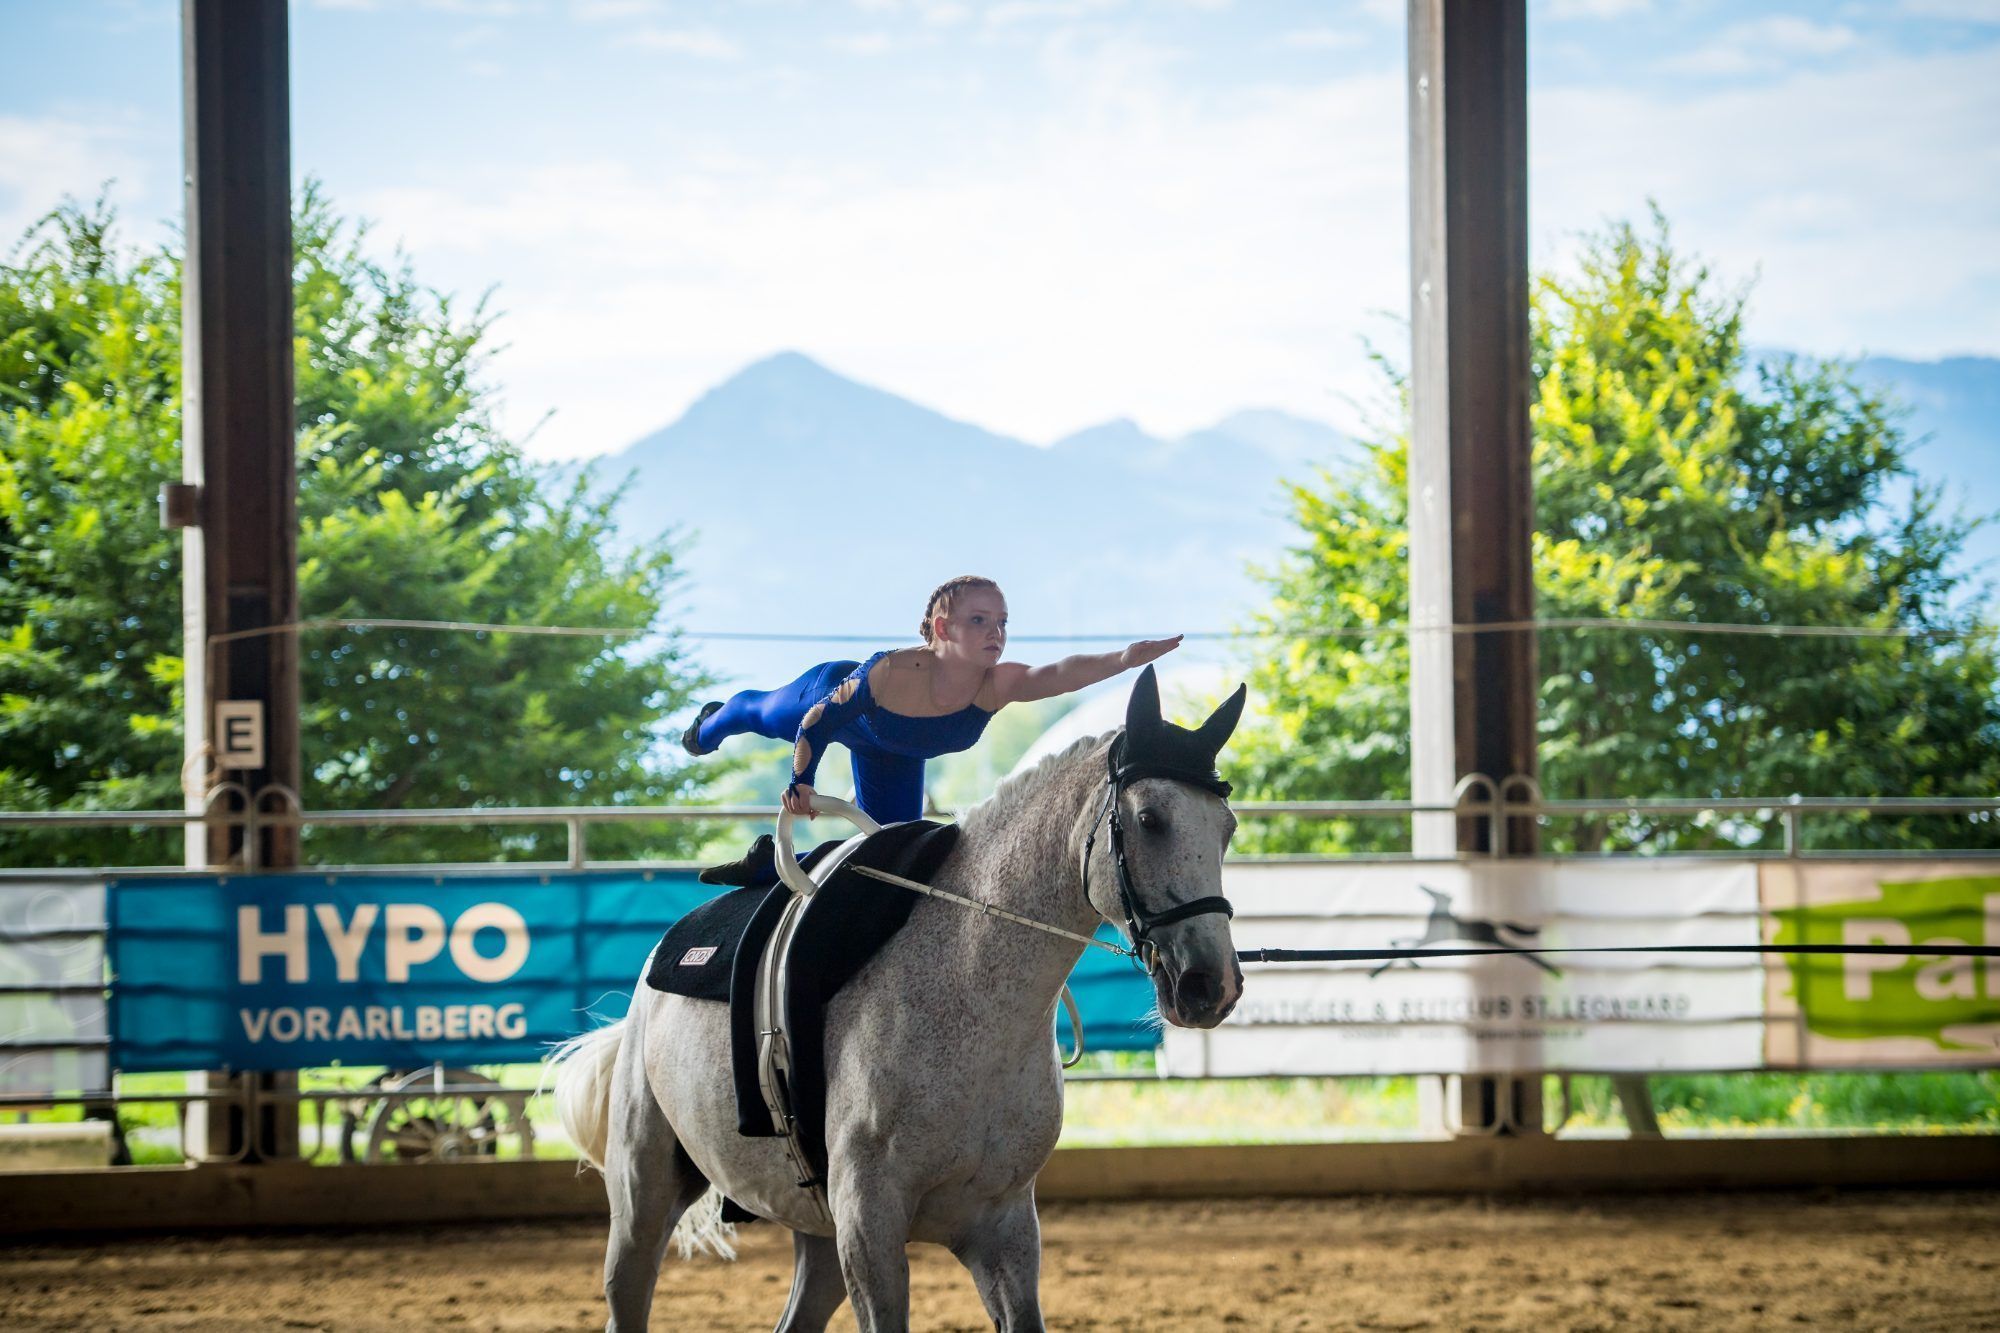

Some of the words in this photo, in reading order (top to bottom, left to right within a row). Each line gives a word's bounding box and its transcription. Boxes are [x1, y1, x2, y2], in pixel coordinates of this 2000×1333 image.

[225, 715, 253, 752] E
[238, 902, 531, 983] HYPO
[240, 1003, 528, 1043] VORARLBERG
[1372, 997, 1390, 1021] &
[1562, 992, 1691, 1020] LEONHARD
